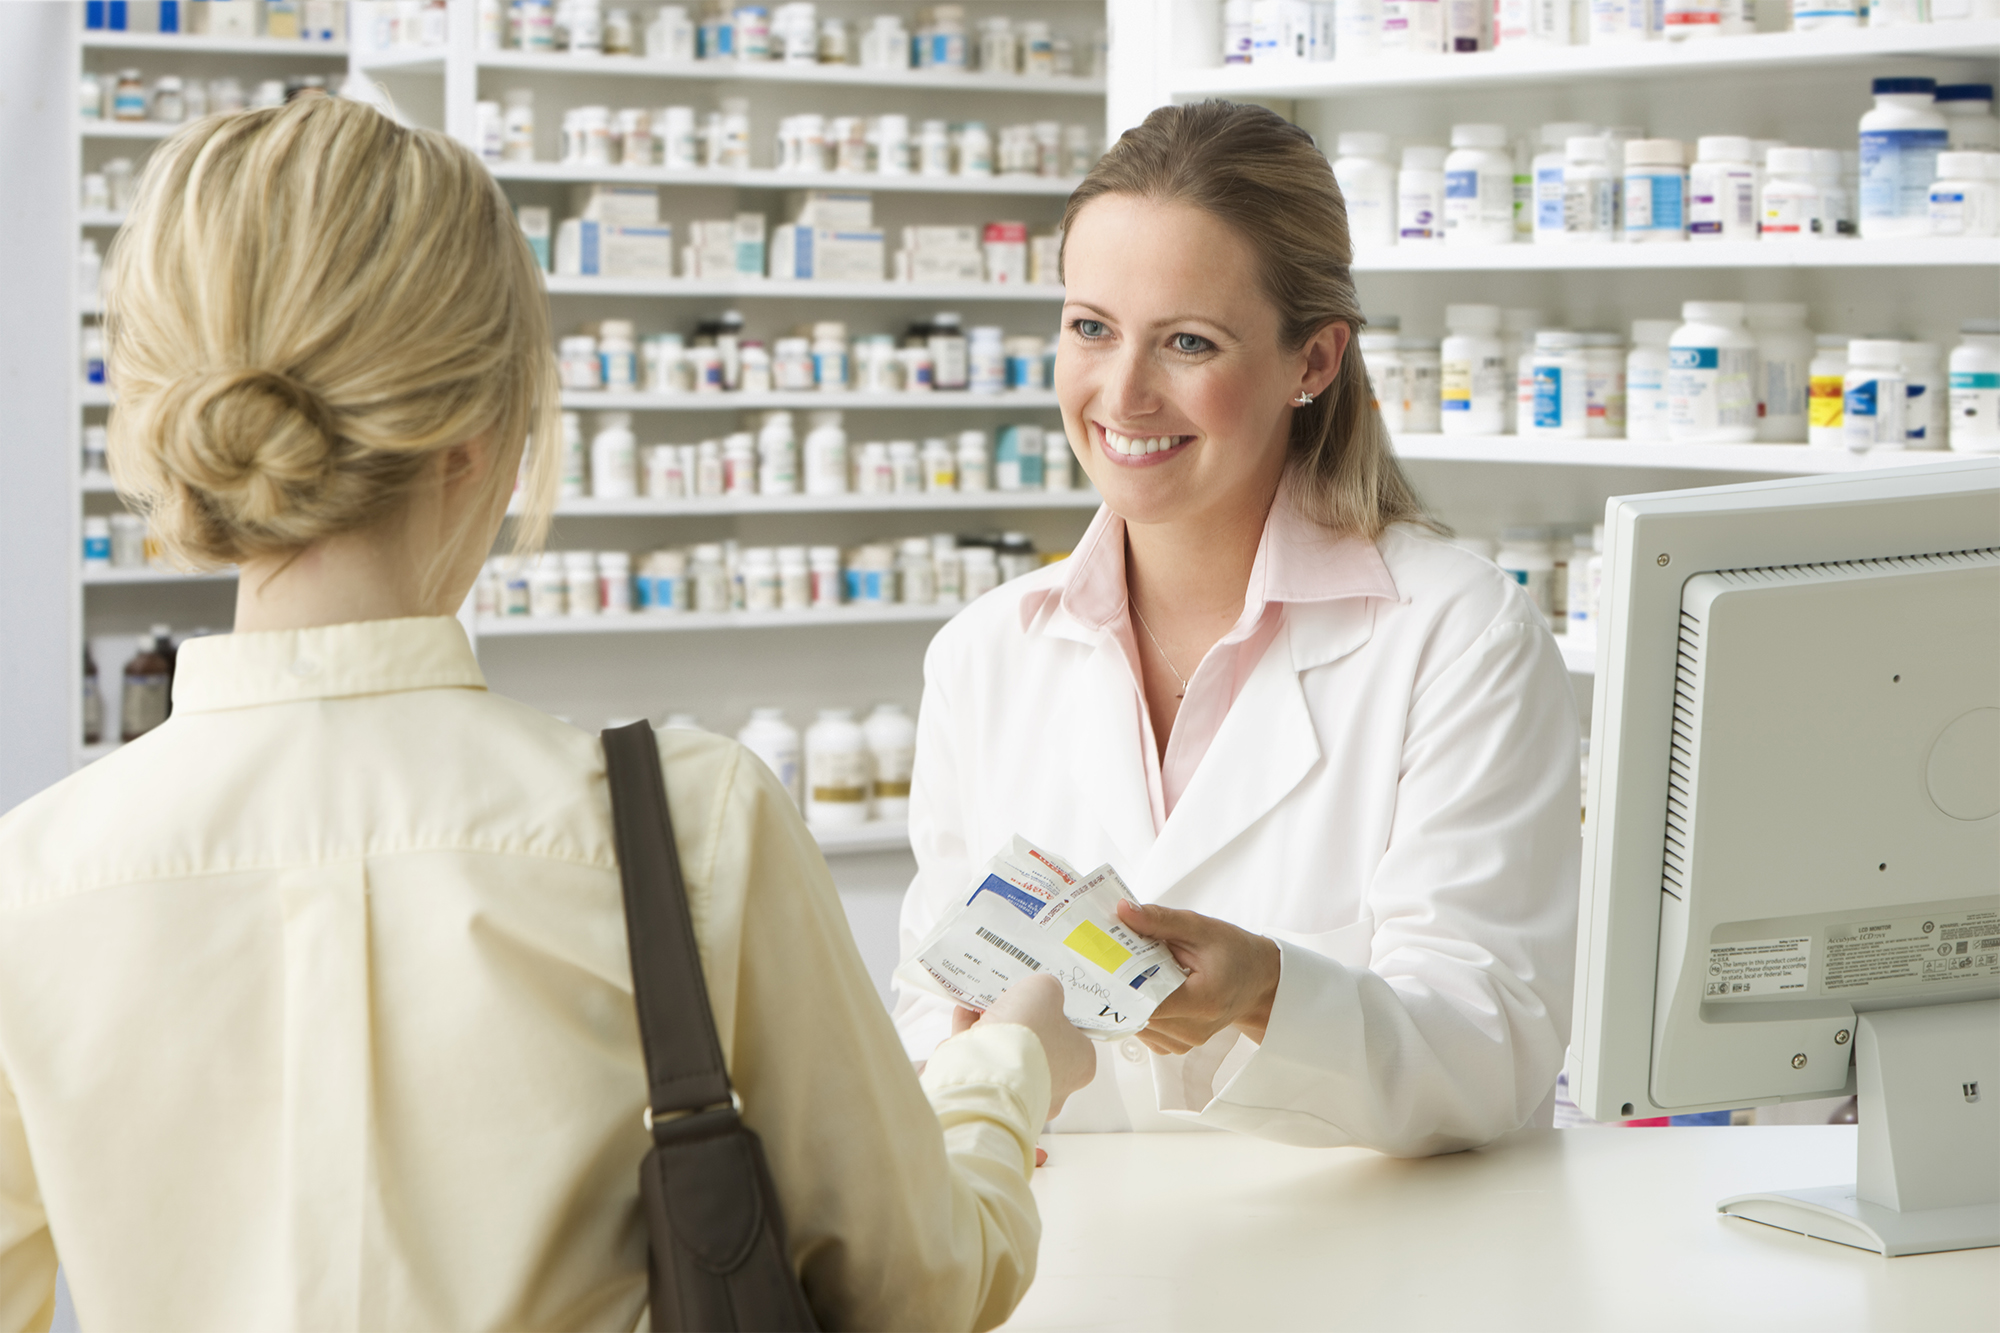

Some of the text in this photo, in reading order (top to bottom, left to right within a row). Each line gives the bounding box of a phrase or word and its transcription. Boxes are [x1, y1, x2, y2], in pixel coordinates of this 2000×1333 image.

[1765, 958, 1786, 966] product
[928, 967, 964, 997] RECEIPT
[1098, 1004, 1127, 1024] M
